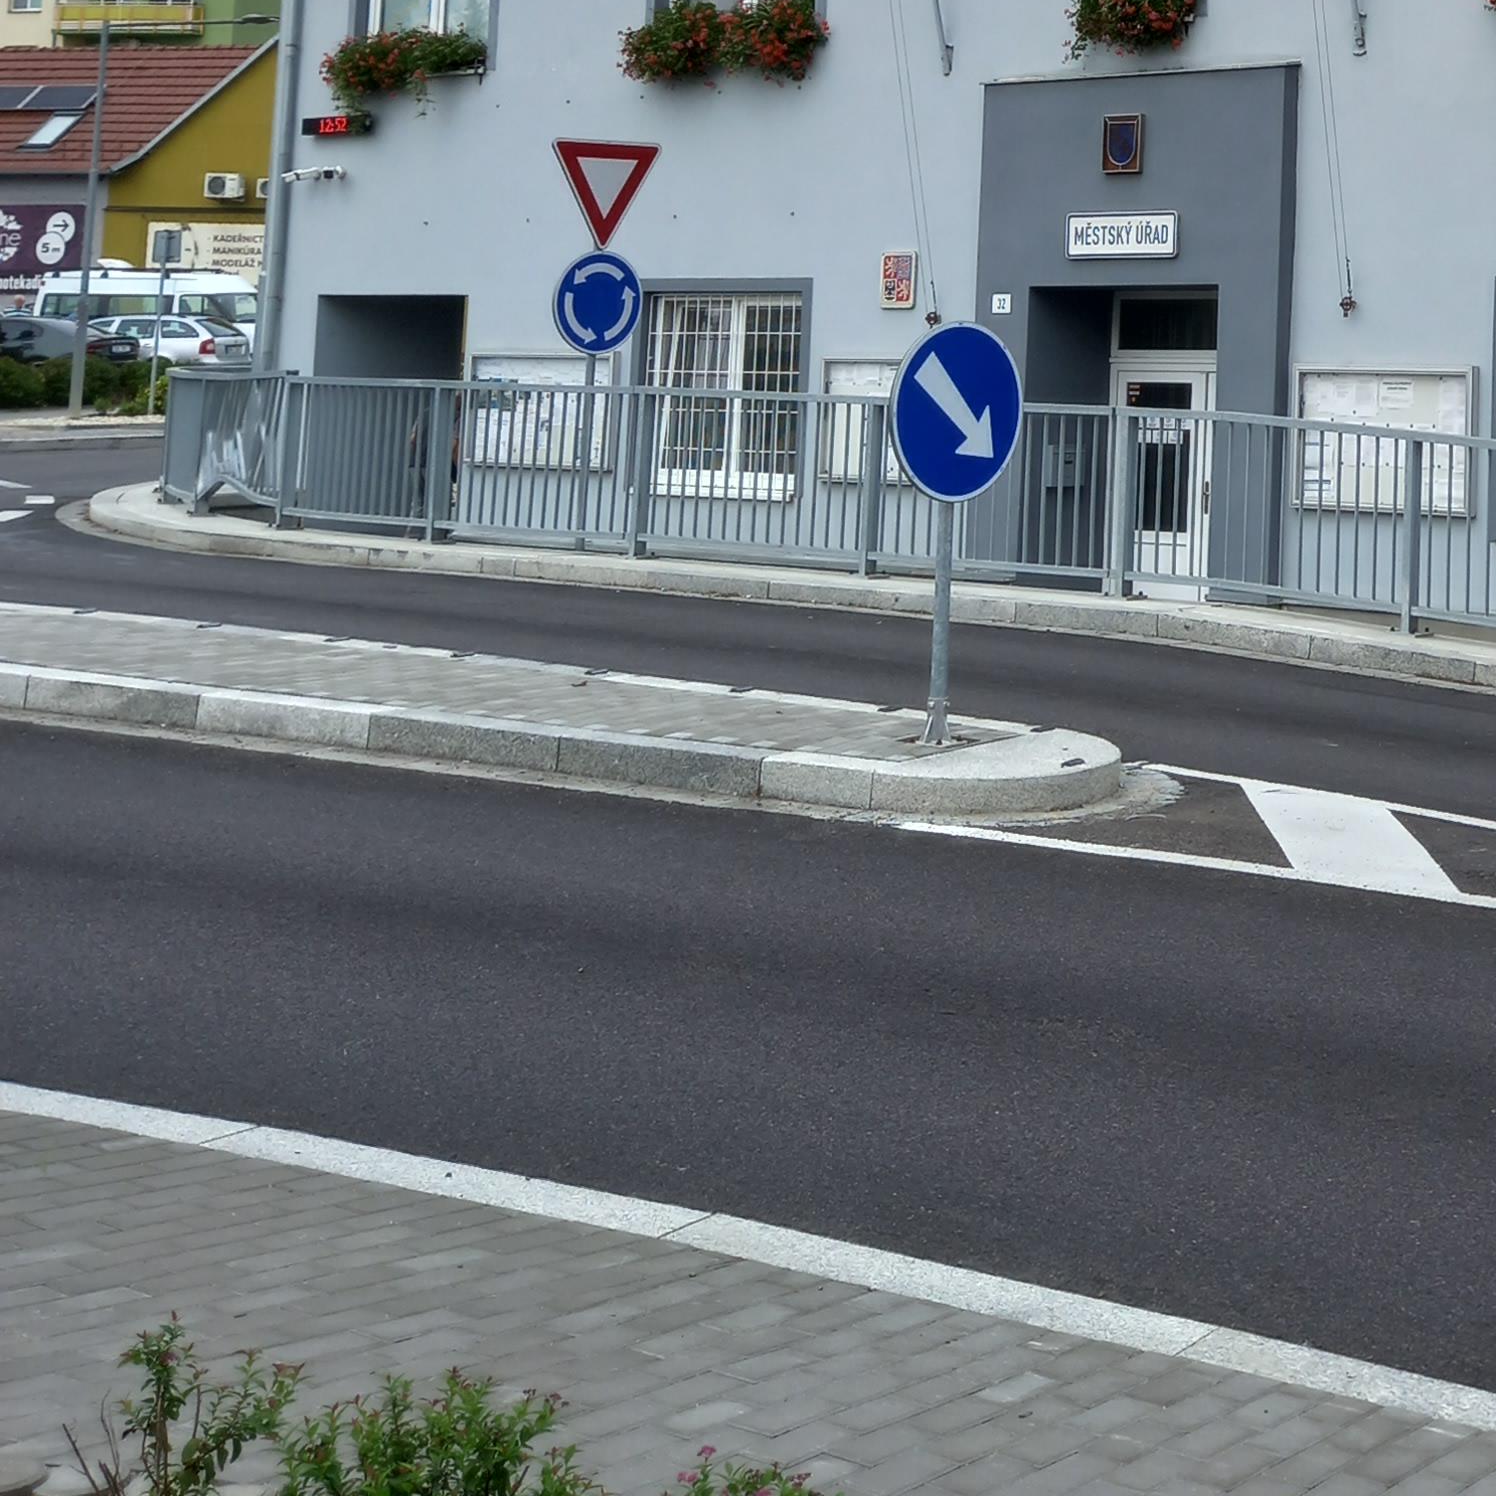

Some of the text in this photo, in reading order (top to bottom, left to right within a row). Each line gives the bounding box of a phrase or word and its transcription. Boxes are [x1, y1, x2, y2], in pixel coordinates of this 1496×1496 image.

[1074, 221, 1169, 246] MĚSTSKÝ ÚŘAD
[40, 242, 51, 254] 5
